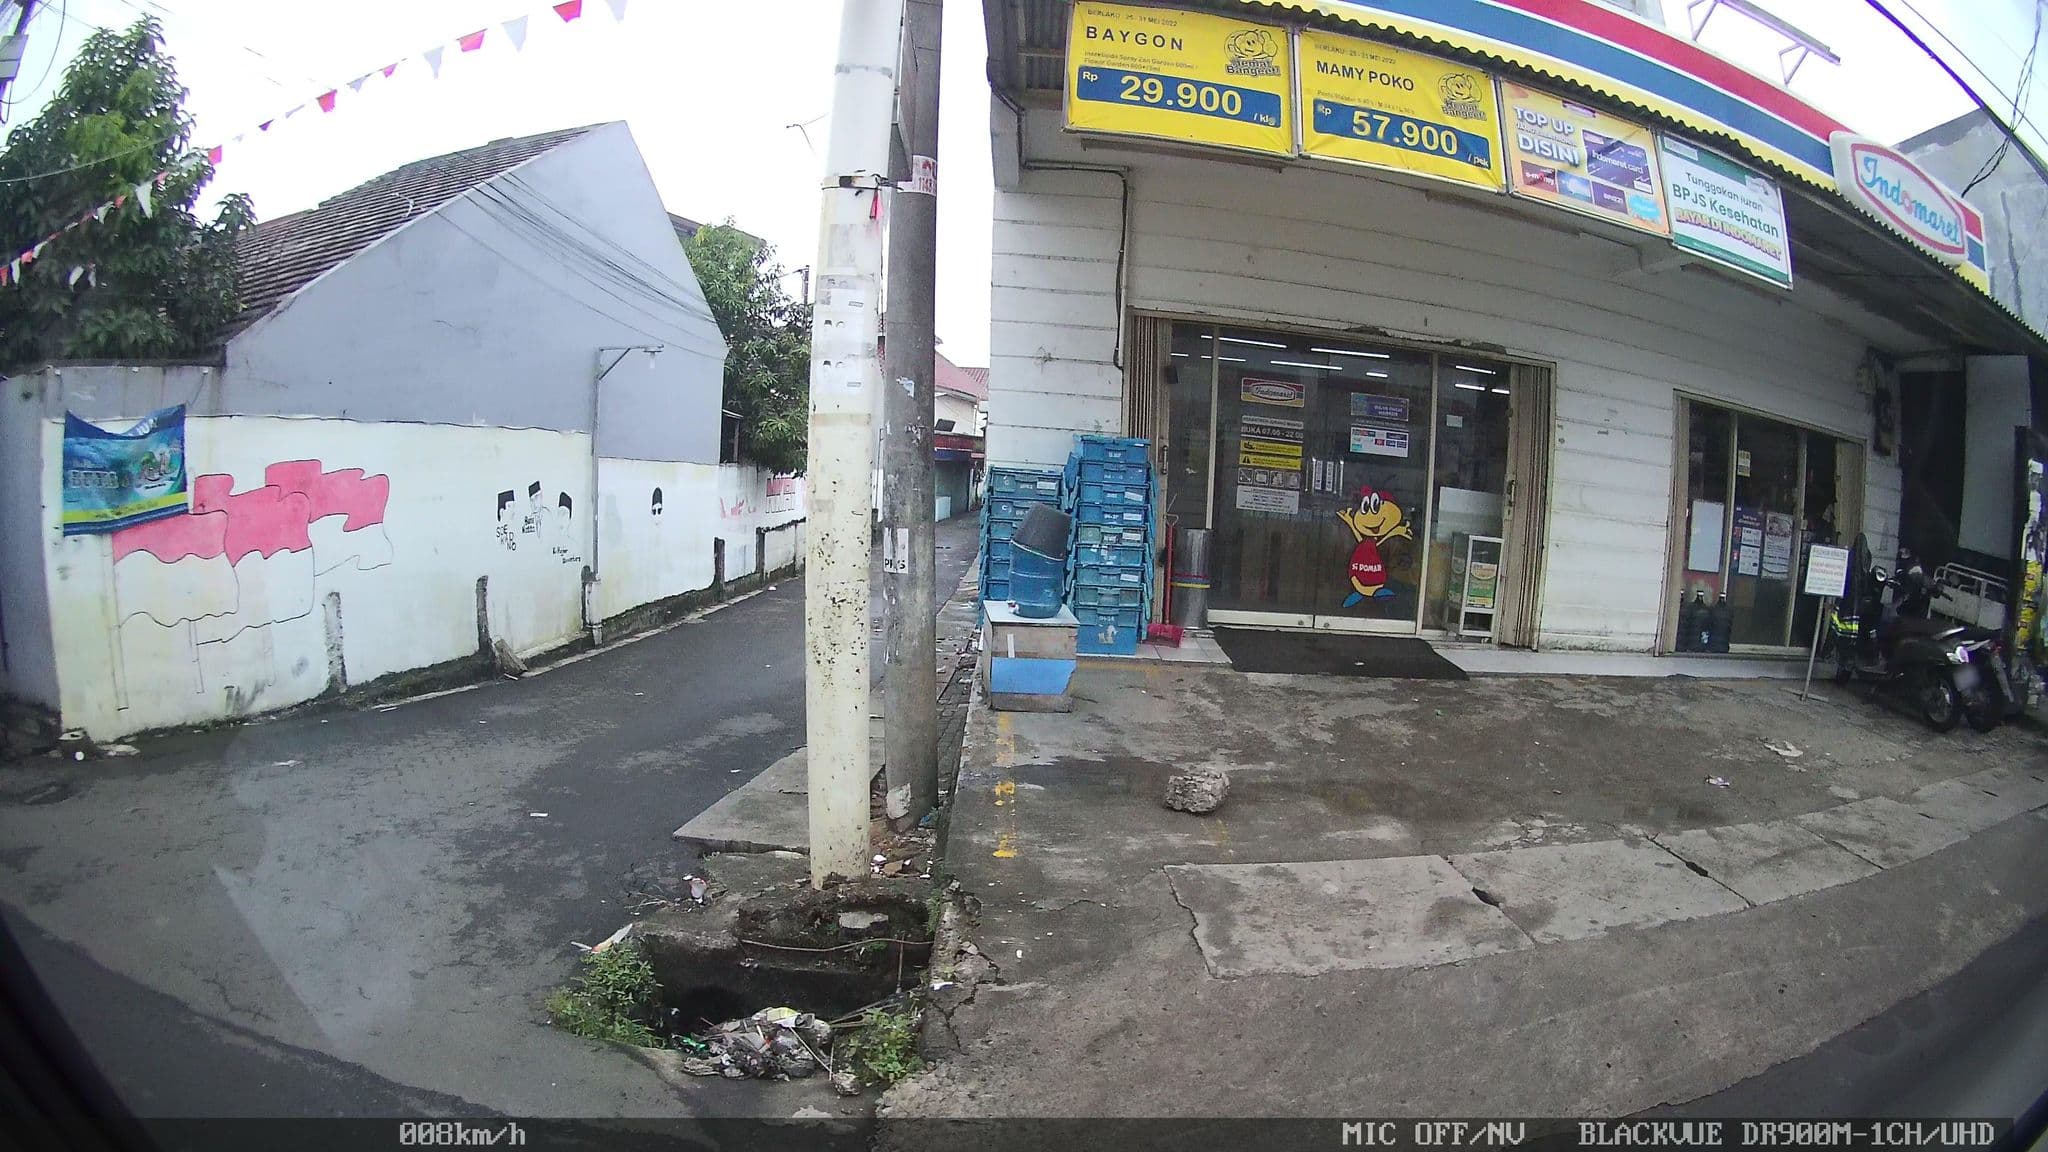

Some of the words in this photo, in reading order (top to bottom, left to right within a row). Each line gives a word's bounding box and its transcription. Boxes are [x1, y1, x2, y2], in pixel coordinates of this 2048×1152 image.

[1086, 26, 1183, 51] BAYGON
[1316, 60, 1364, 81] MAMY
[1368, 70, 1414, 91] POKO
[1082, 70, 1098, 83] Rp
[1120, 75, 1242, 117] 29.900
[1317, 104, 1332, 116] Rp
[1352, 110, 1458, 155] 57.900
[1513, 105, 1548, 128] TOP
[1551, 118, 1575, 136] UP
[1517, 132, 1580, 167] DISINI
[1685, 171, 1739, 202] Tunggakan
[1860, 156, 1961, 246] Indomaret
[1672, 184, 1707, 208] BPJS
[1709, 197, 1779, 238] Kesehatan
[1241, 424, 1261, 435] BUKA
